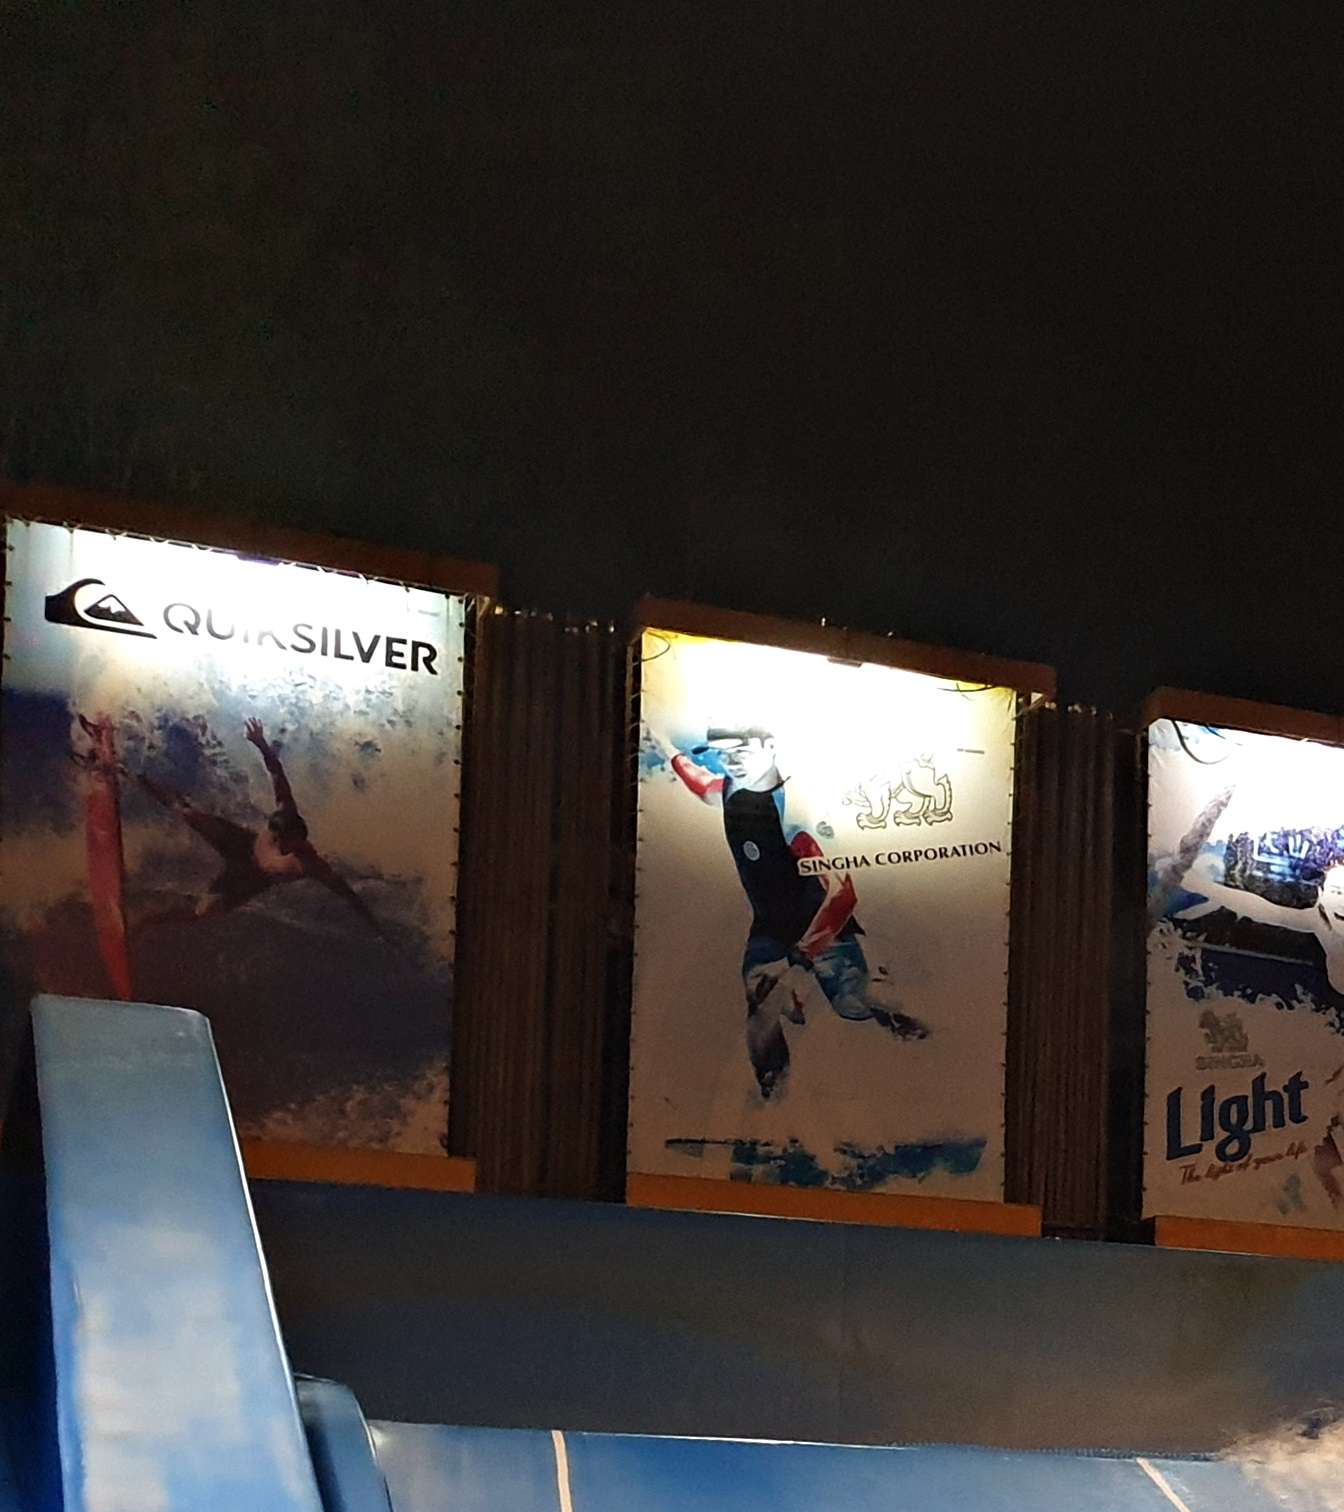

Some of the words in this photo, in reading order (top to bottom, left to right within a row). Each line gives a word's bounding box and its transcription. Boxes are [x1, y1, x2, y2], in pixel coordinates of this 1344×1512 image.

[800, 854, 870, 874] SINGHA
[875, 841, 1002, 866] CORPORATION
[1166, 1070, 1309, 1162] Light
